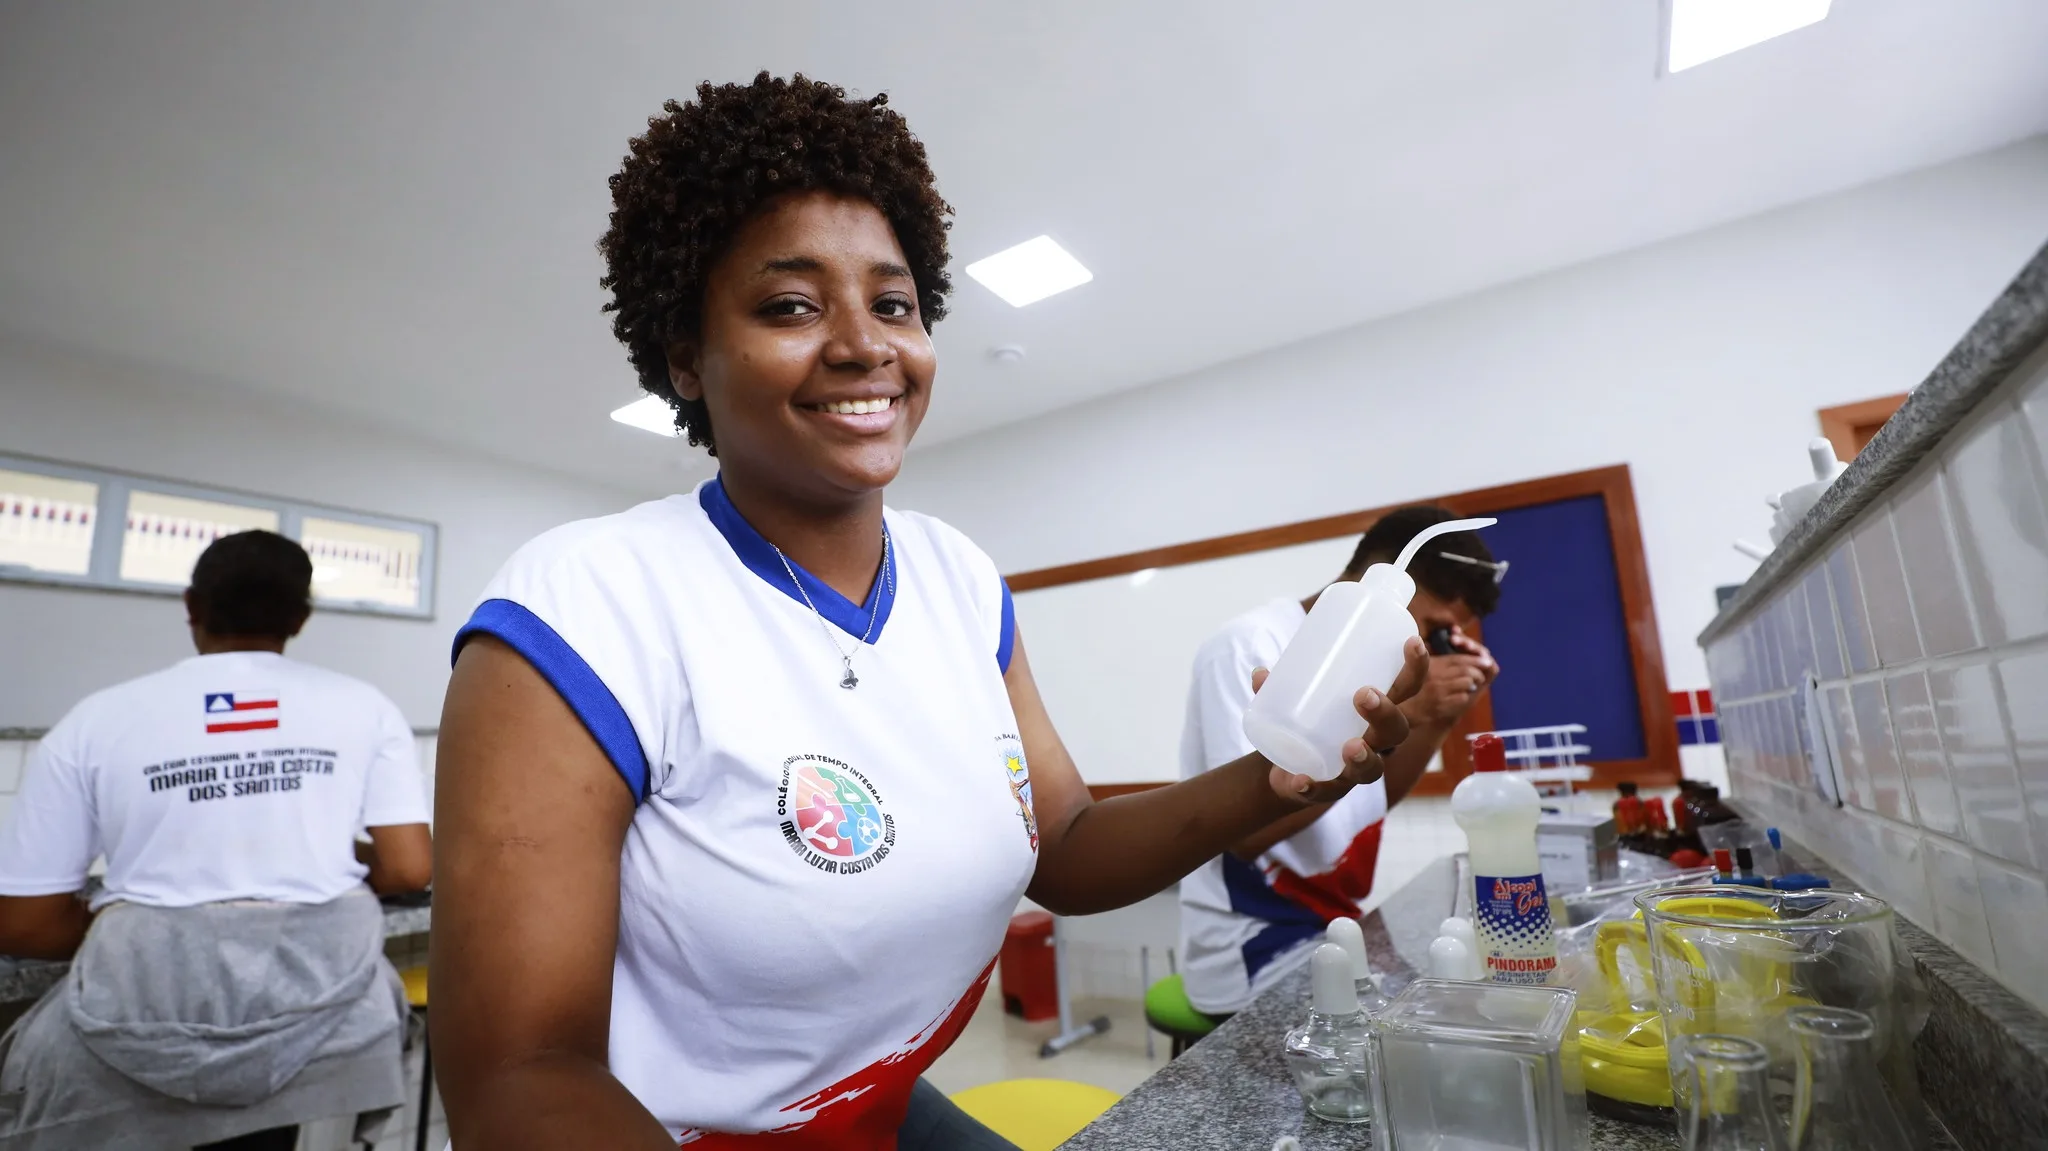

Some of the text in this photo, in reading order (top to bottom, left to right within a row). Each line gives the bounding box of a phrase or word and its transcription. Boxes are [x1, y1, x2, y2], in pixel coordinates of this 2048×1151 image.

[150, 758, 335, 793] MARIA LUZIA COSTA
[188, 775, 302, 803] DOS SANTOS
[816, 754, 848, 770] TEMPO
[849, 767, 883, 805] INTEGRAL
[804, 850, 837, 874] LUZIA
[840, 856, 874, 875] COSTA
[872, 843, 890, 864] DOS
